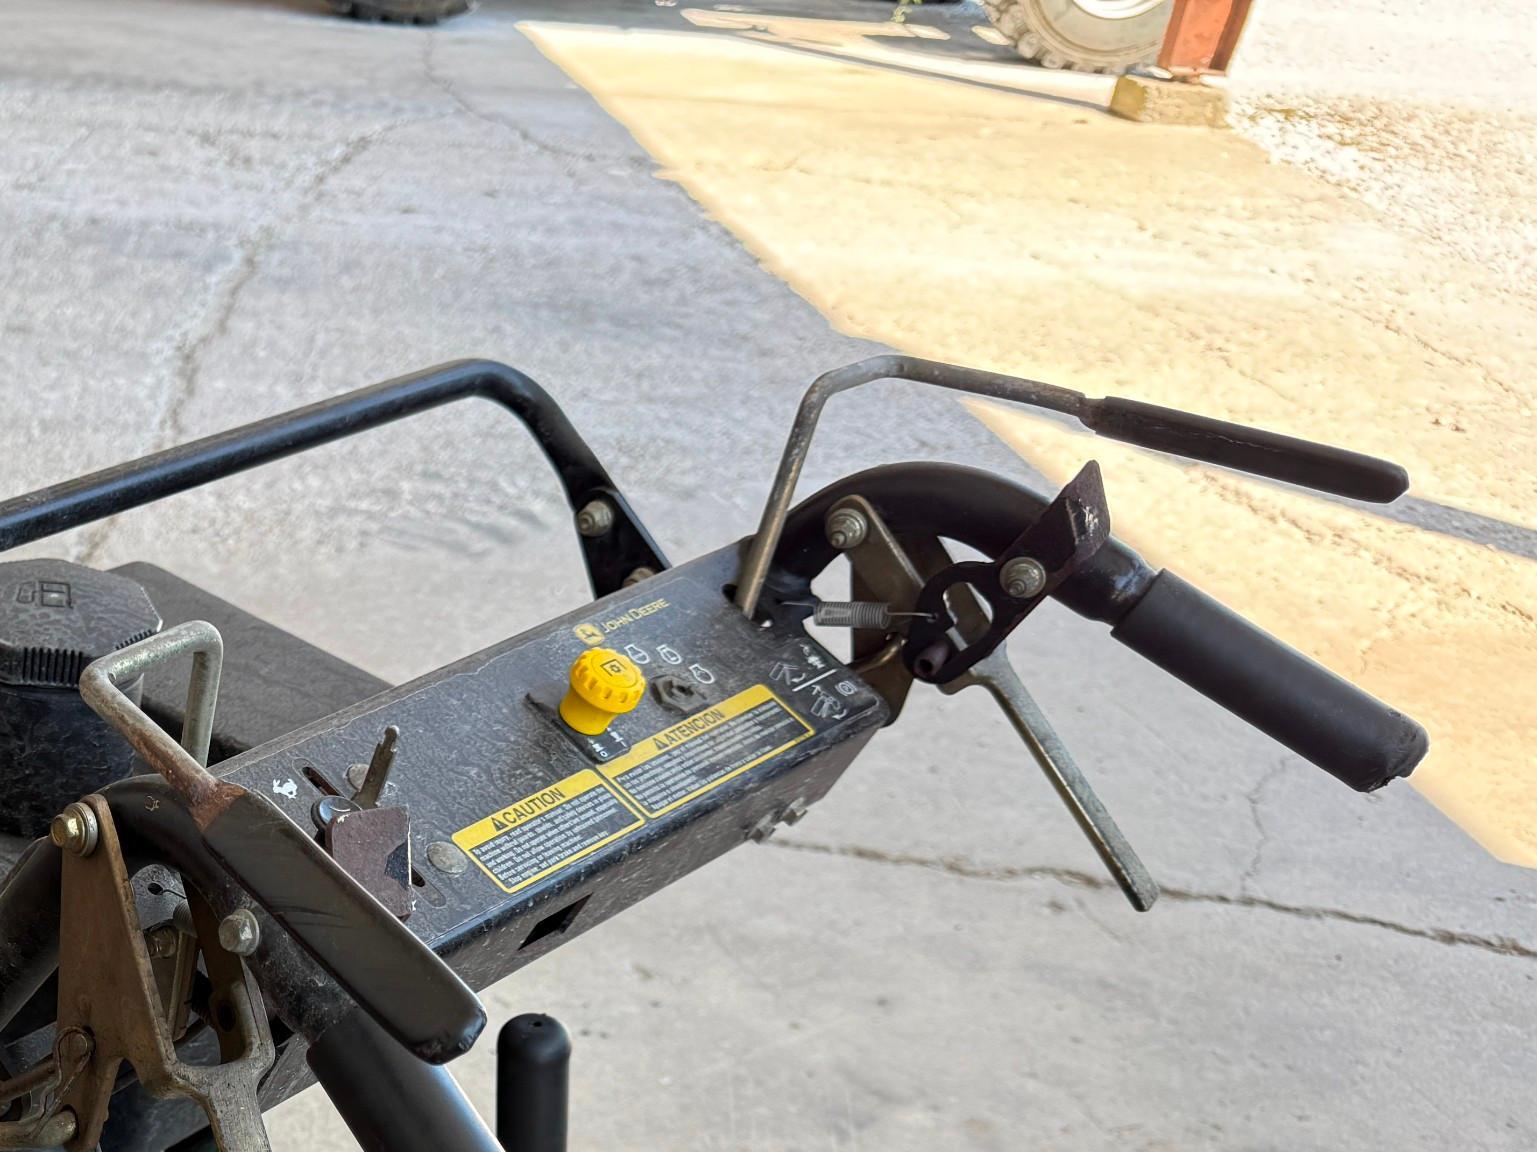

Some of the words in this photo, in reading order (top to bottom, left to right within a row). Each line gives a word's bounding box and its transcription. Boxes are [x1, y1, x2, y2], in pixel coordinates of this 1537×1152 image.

[600, 613, 634, 633] JOHN
[628, 598, 670, 620] DEERE
[666, 708, 726, 747] ATENCION
[502, 787, 565, 826] CAUTION
